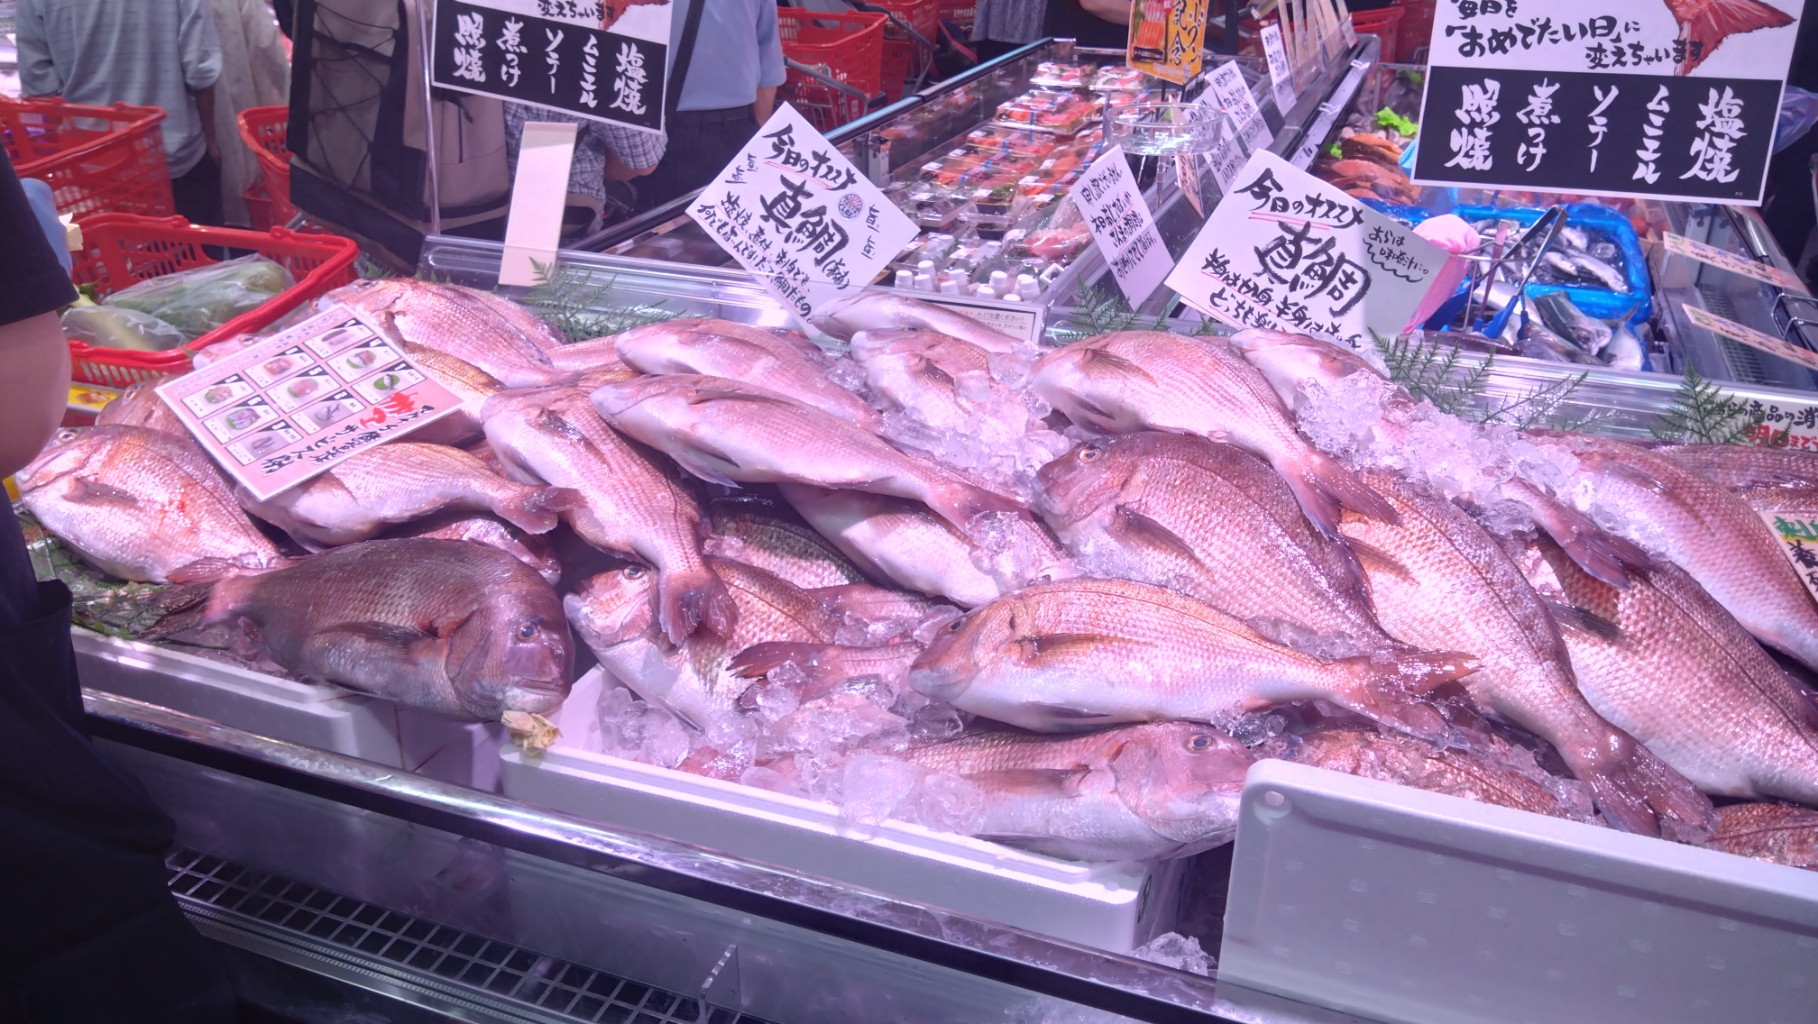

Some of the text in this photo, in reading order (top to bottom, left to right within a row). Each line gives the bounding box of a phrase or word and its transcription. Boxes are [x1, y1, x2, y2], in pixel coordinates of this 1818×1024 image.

[453, 12, 487, 83] 照焼
[545, 28, 564, 94] ソテー
[579, 34, 600, 109] ムニエル
[609, 42, 649, 115] 塩焼
[1585, 39, 1705, 69] 変えちゃいます
[1445, 78, 1501, 171] 照焼
[1587, 85, 1619, 173] ソテー
[1632, 85, 1672, 185] ムニエル
[1679, 85, 1748, 184] 塩焼
[759, 173, 849, 267] 真鯛
[1234, 167, 1365, 229] 今日のオススメ
[1253, 220, 1373, 318] 真鯛
[1368, 225, 1405, 247] あらは
